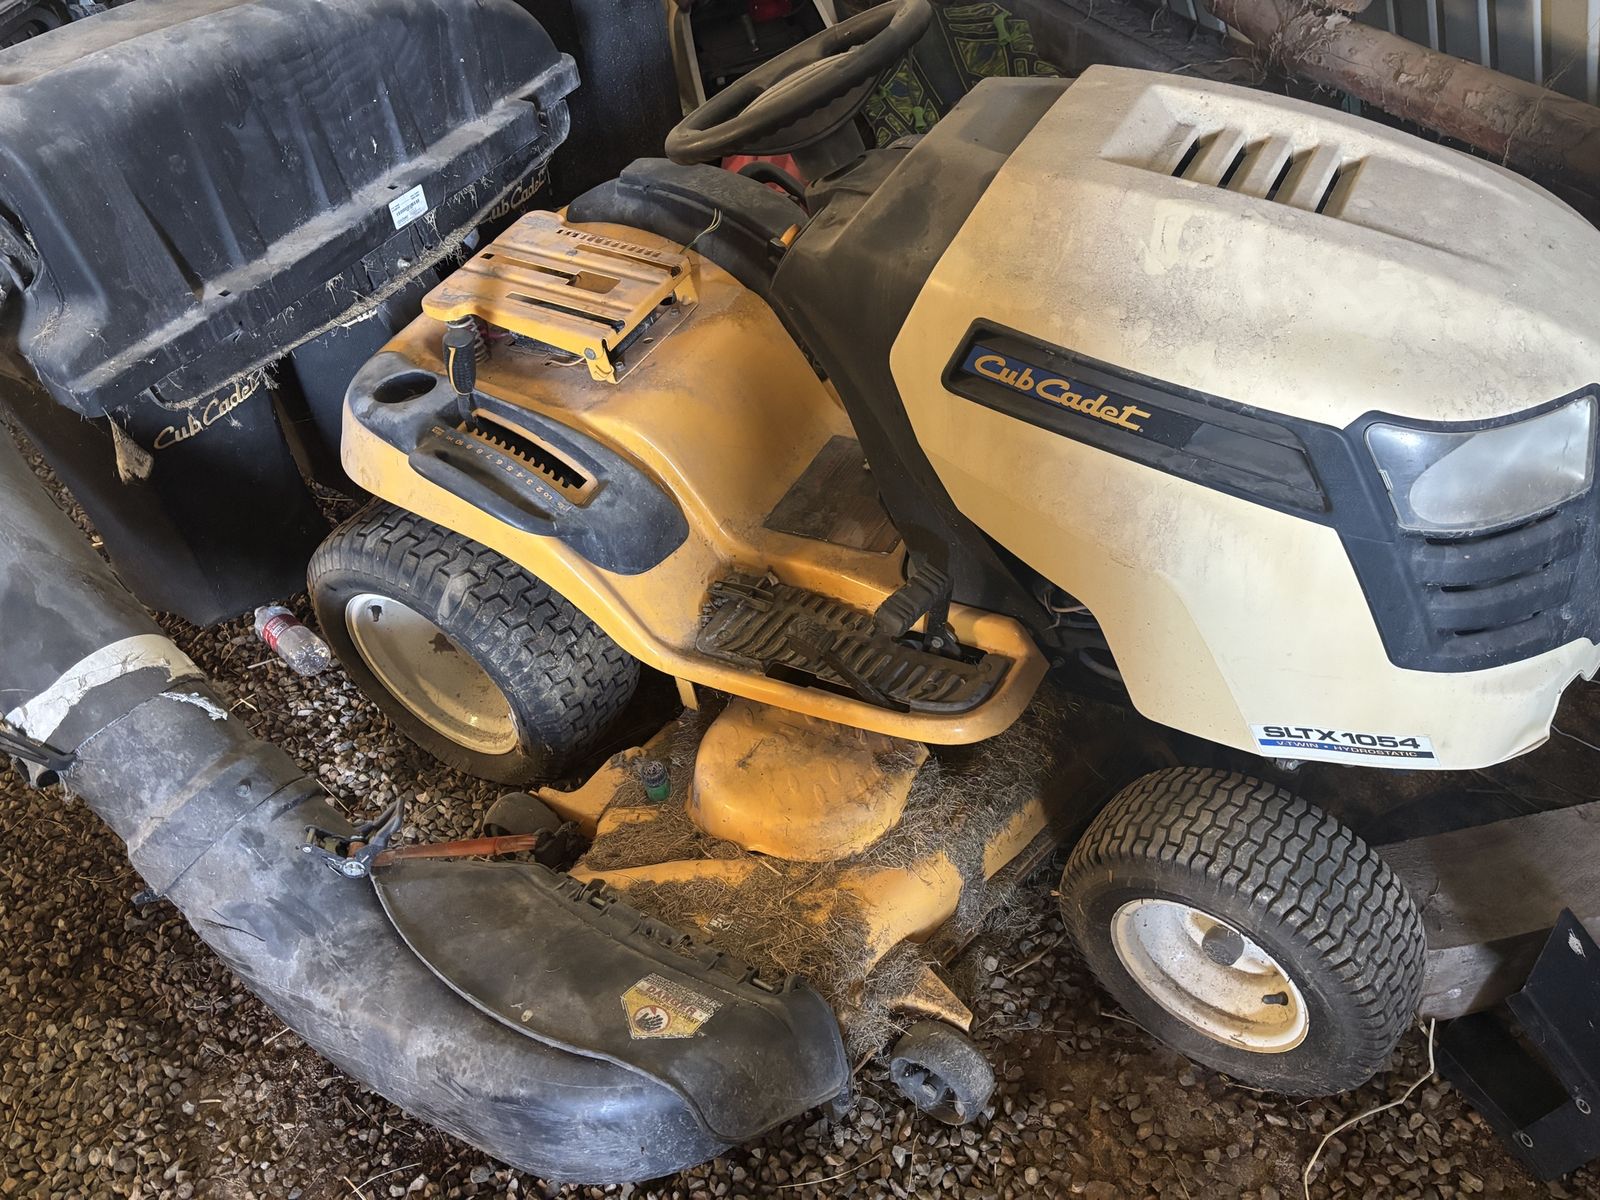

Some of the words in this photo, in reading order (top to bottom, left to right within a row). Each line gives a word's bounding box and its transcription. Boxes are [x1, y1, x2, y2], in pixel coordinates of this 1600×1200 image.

[153, 414, 203, 449] Cub
[203, 375, 260, 426] Cadet
[974, 354, 1034, 391] Cub
[1035, 378, 1151, 432] Cadet
[1333, 745, 1418, 757] HYDROSTATIC
